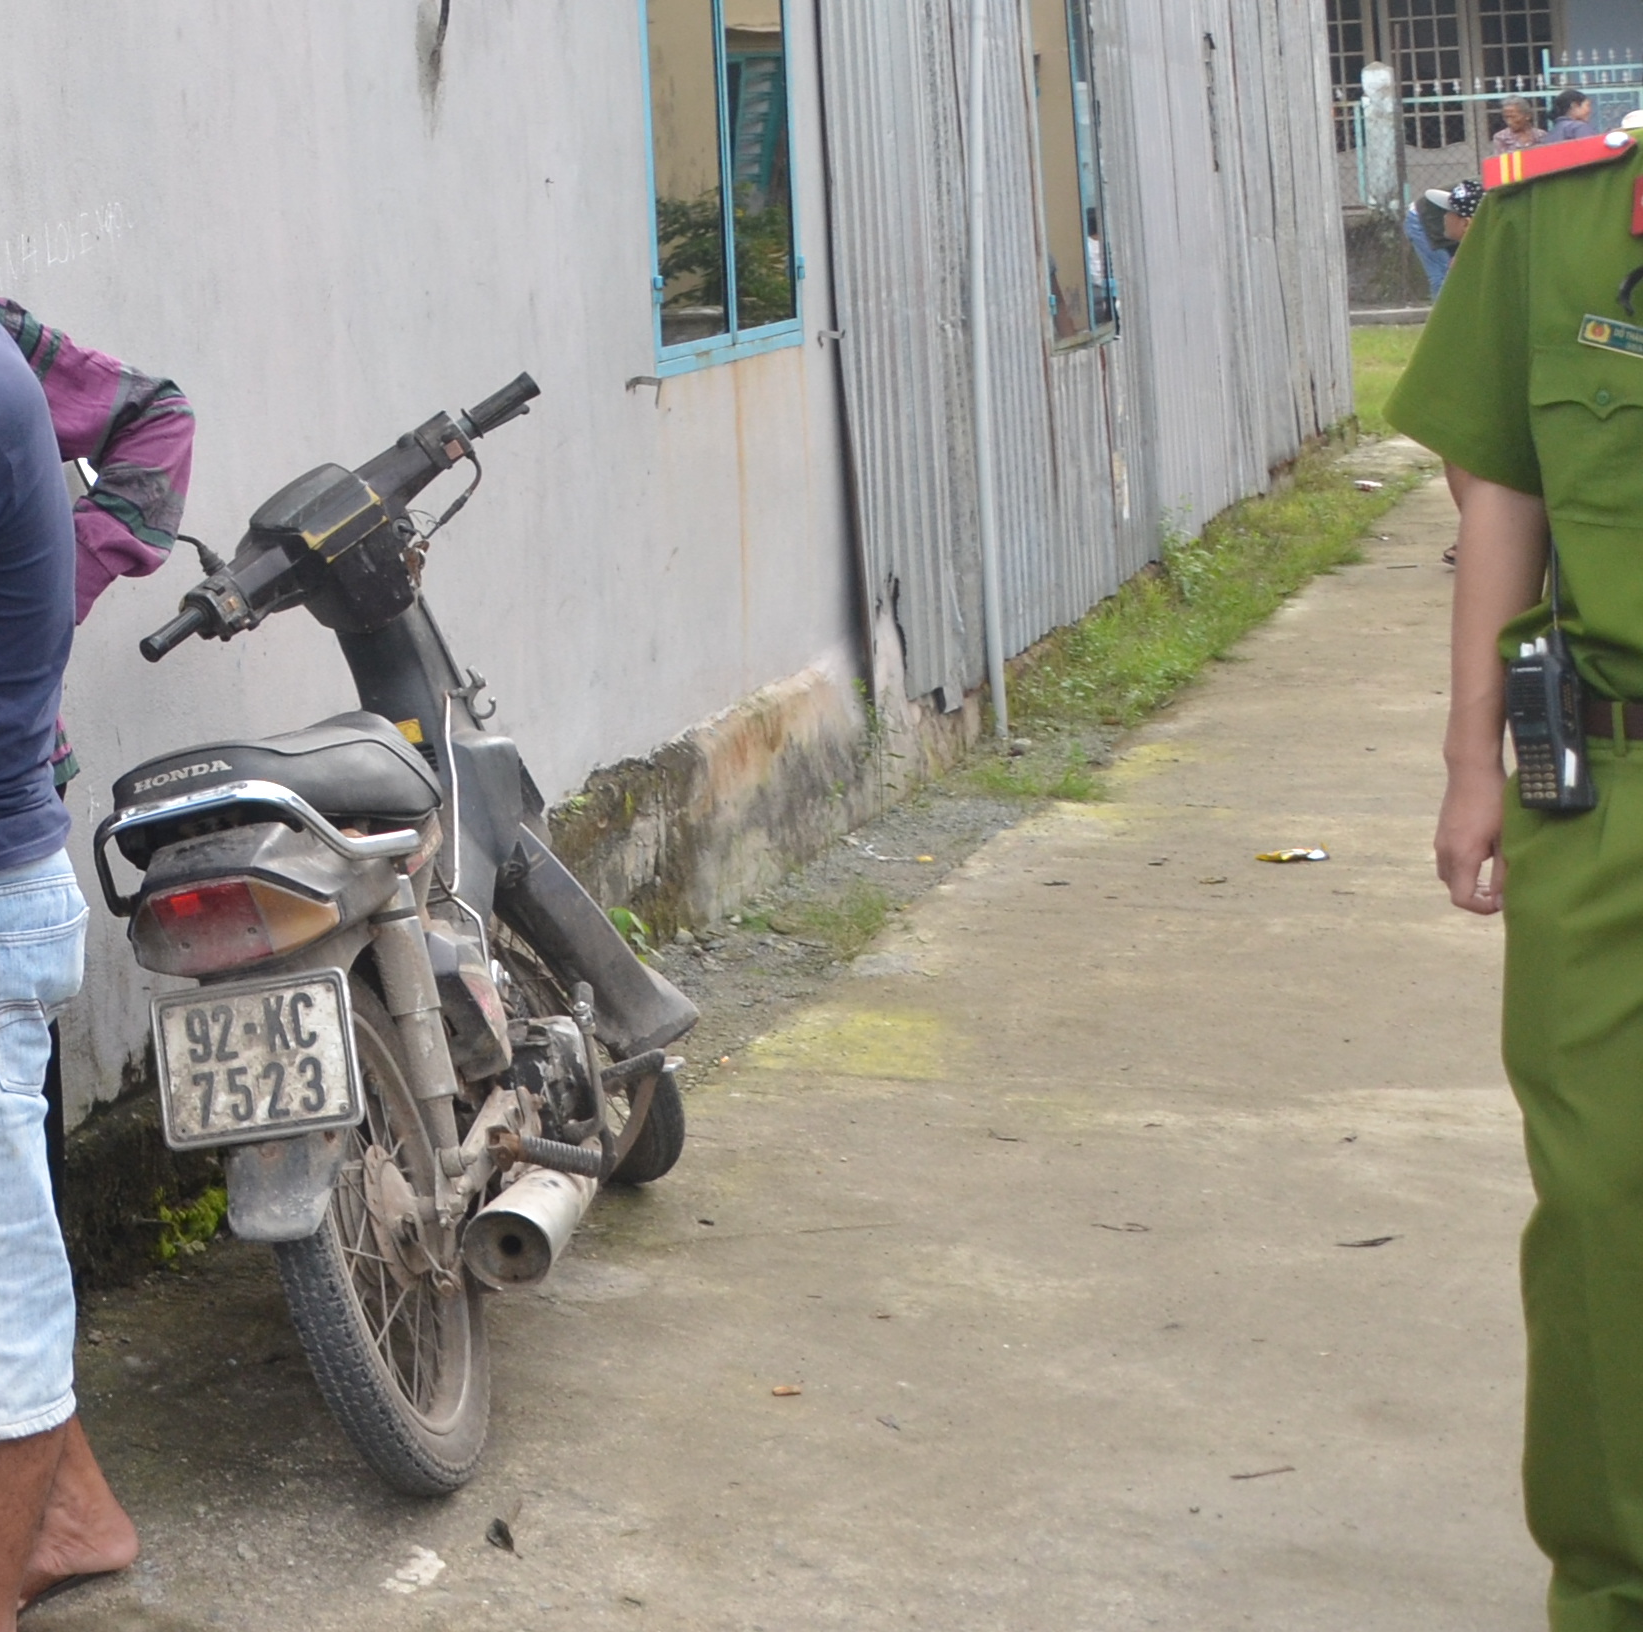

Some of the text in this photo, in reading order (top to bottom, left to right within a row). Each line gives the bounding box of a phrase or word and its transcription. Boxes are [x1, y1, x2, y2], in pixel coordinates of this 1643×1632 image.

[133, 759, 234, 794] HONDA
[185, 992, 318, 1065] 92-KC
[191, 1056, 326, 1130] 7523
